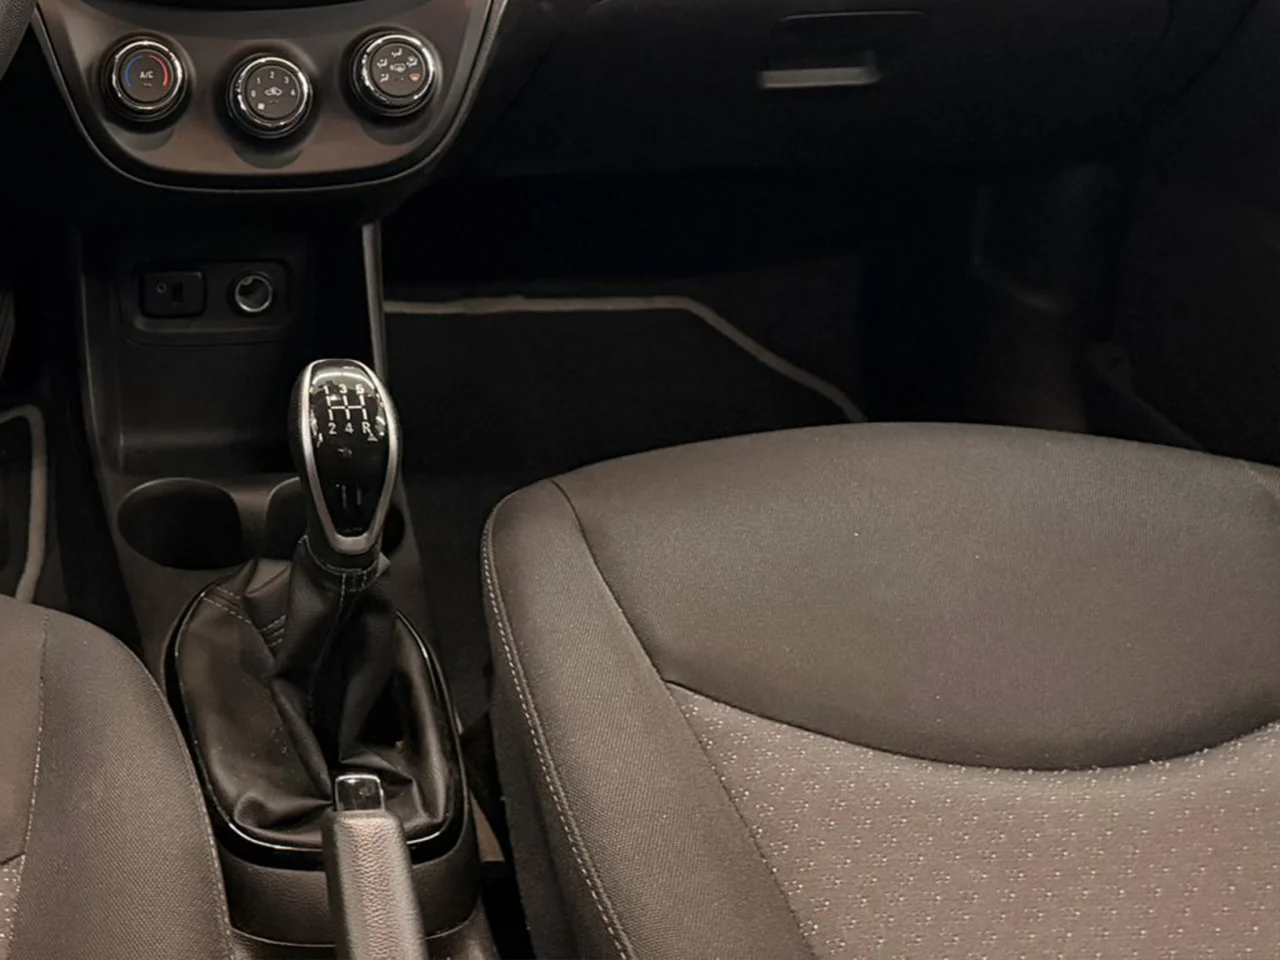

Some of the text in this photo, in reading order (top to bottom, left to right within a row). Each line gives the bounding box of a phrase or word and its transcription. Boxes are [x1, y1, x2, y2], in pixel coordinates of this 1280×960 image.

[139, 71, 154, 79] A/C
[339, 384, 348, 394] 3
[355, 384, 365, 395] 5
[328, 421, 371, 435] 2 4 R
